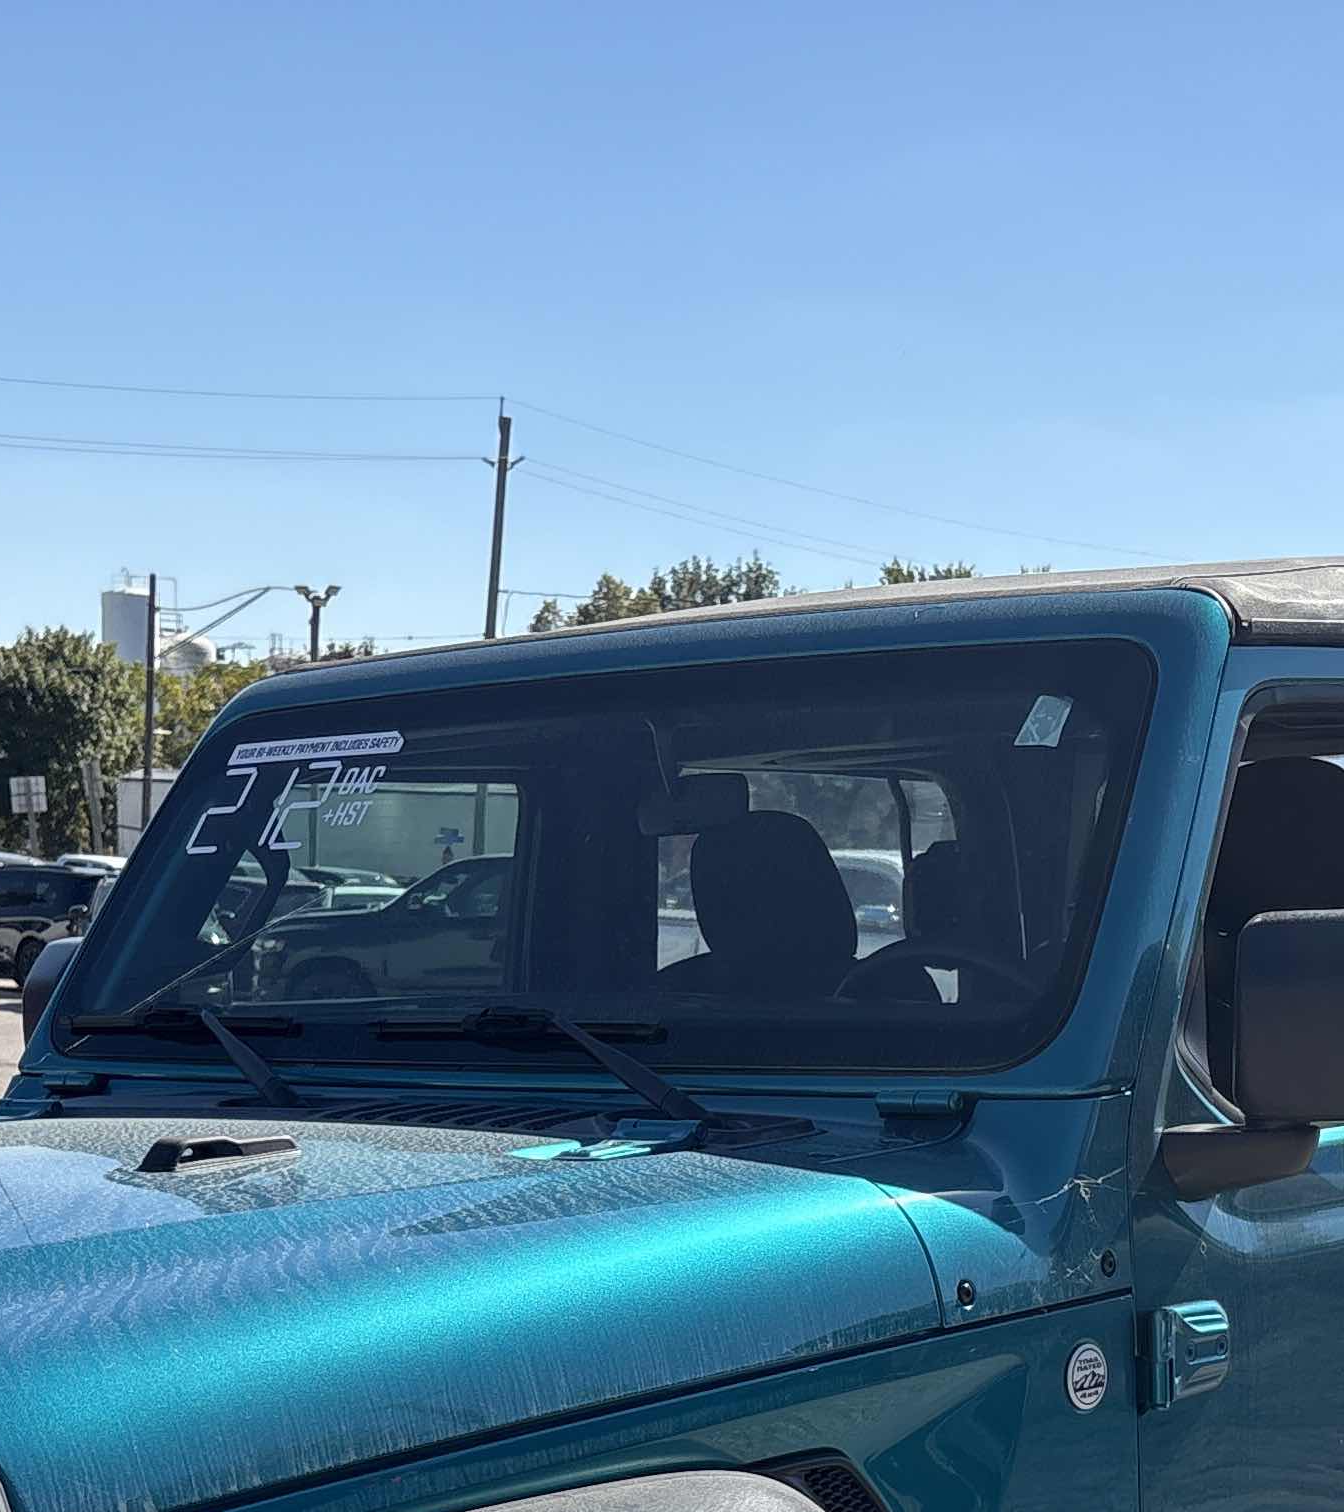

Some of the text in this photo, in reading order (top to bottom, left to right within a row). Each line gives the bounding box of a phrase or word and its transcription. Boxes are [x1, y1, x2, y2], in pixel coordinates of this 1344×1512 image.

[236, 747, 257, 761] YOUR
[294, 741, 333, 756] PAYMENT
[330, 738, 369, 753] INCLUDES
[368, 736, 401, 751] SAFETY
[336, 765, 388, 796] DAC
